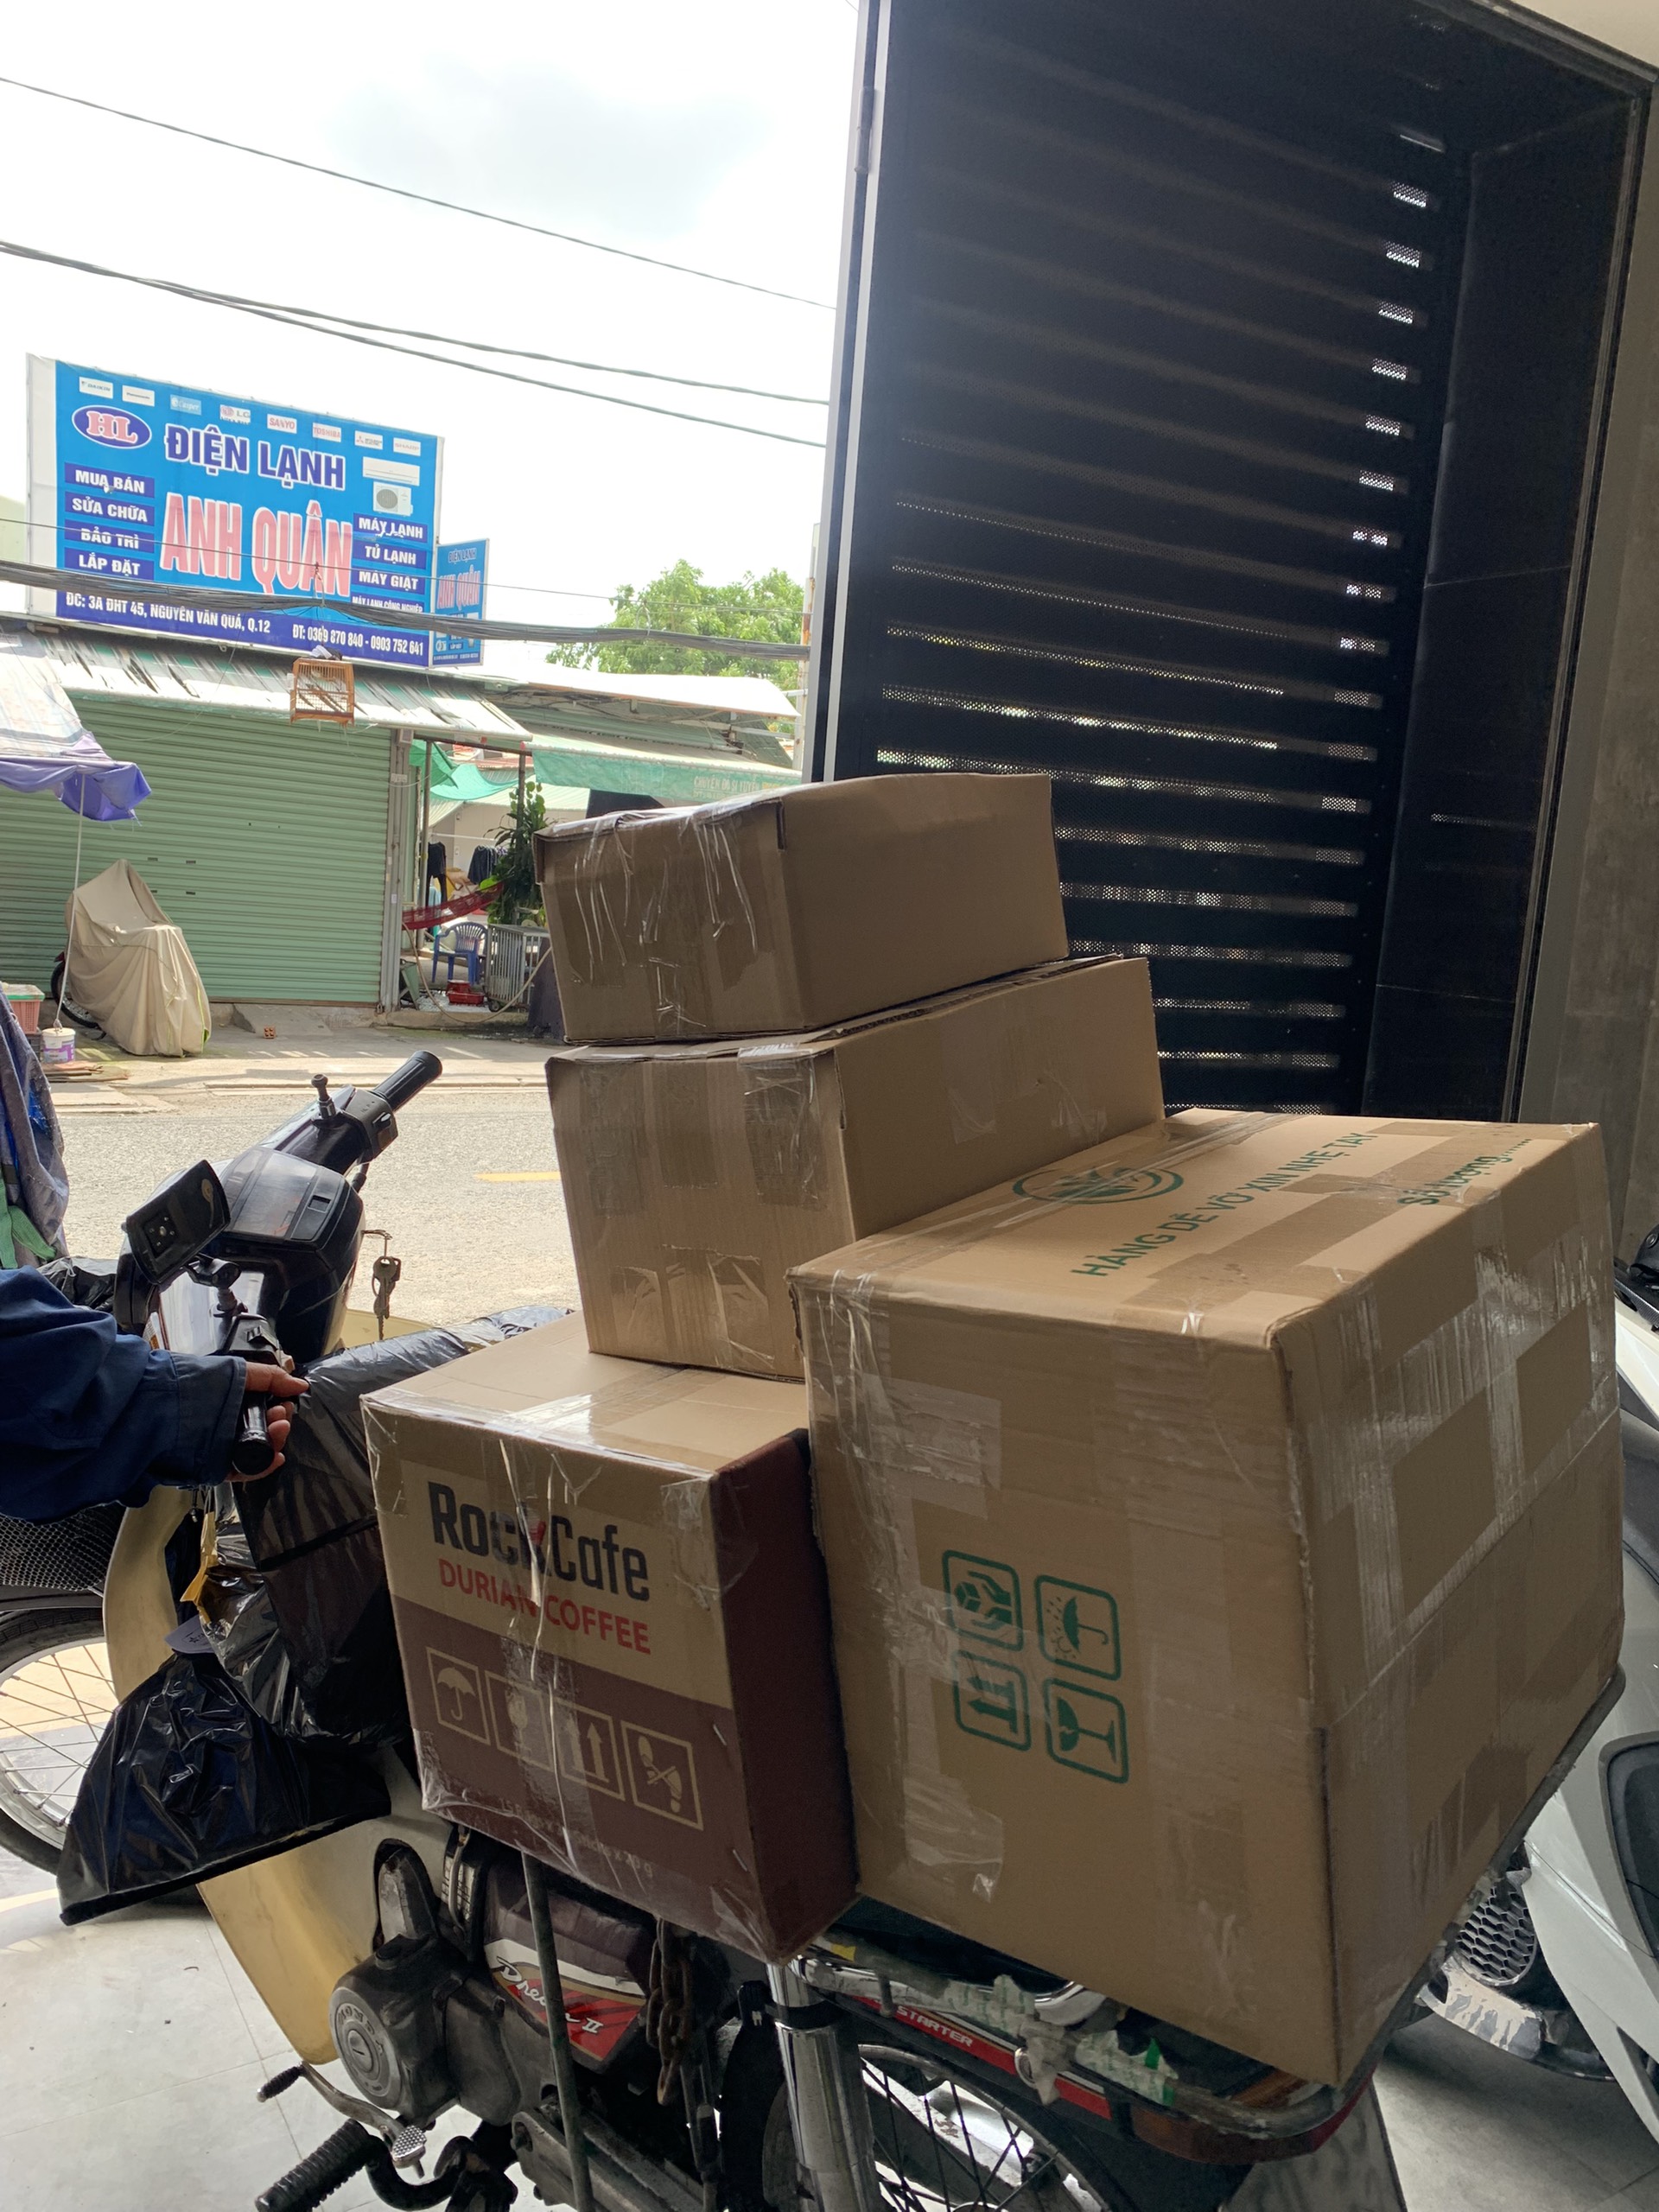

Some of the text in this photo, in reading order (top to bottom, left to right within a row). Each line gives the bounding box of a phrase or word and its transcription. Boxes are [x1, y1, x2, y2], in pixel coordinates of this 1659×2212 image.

[86, 410, 138, 444] HL
[236, 410, 251, 419] LG
[269, 417, 296, 430] SANYO
[313, 426, 340, 439] TOSHIBA
[165, 423, 345, 491] ĐIỆN LẠNH
[75, 469, 145, 494] MUA BÁN
[72, 496, 148, 522] SỬA CHỮA
[359, 517, 387, 534] MÁY
[160, 492, 353, 597] ANH QUÂN
[365, 543, 416, 565] TỦ LẠNH
[79, 551, 141, 576] LẮP ĐẶT
[436, 564, 480, 611] ANH QUÂN
[66, 592, 86, 607] ĐC:
[88, 595, 104, 611] 3A
[106, 598, 128, 613] ĐHT
[130, 601, 147, 618] 45,
[196, 609, 219, 626] VĂN
[220, 613, 245, 632] QUÁ,
[248, 617, 270, 633] Q.12
[293, 624, 306, 639] ĐT:
[330, 629, 346, 645] 870
[347, 632, 363, 648] 840
[371, 635, 391, 652] 0903
[392, 638, 408, 654] 752
[410, 640, 423, 656] 641
[1071, 1132, 1379, 1277] HÀNG DỄ VỠ XIN NHẸ TAY
[439, 1558, 652, 1656] DURIAN COFFEE
[896, 2005, 974, 2048] STARTER
